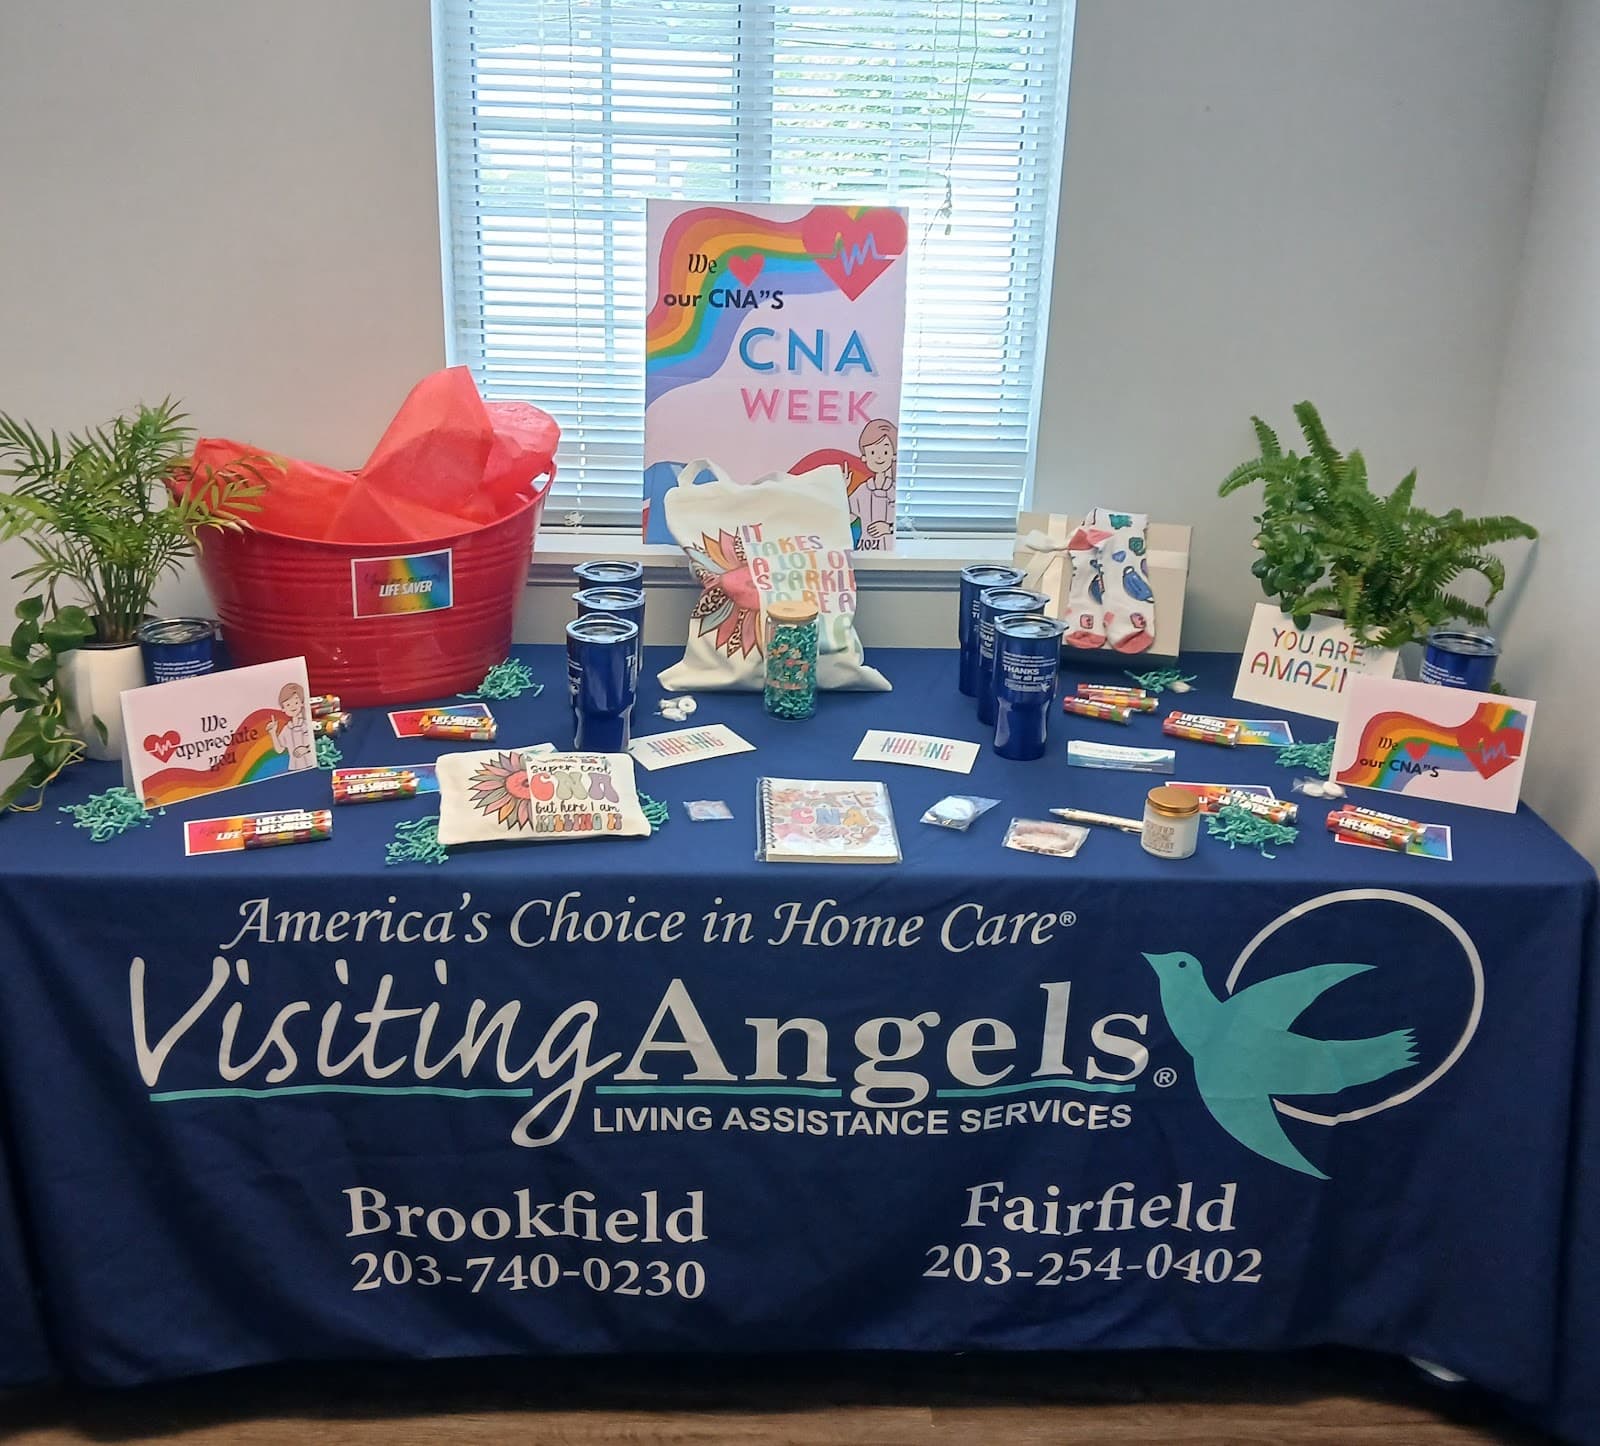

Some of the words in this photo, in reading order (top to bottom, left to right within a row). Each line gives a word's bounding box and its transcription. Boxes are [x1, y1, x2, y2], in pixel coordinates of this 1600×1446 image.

[688, 253, 718, 274] We
[663, 292, 702, 309] our
[738, 326, 878, 377] CNA
[740, 388, 878, 424] WEEK
[742, 523, 762, 543] IT
[749, 535, 824, 556] TAKES
[752, 557, 769, 576] A
[777, 550, 818, 570] LOT
[379, 584, 401, 597] LIFE
[402, 580, 433, 595] SAVER
[1273, 626, 1315, 654] YOU
[1319, 638, 1365, 665] ARE
[1002, 663, 1040, 675] THANKS
[201, 714, 228, 734] We
[176, 726, 259, 760] appreciate
[1379, 736, 1399, 750] We
[208, 751, 237, 773] you
[1359, 757, 1386, 769] our
[530, 770, 620, 804] CNA
[535, 801, 558, 814] but
[560, 800, 588, 814] here
[590, 801, 595, 812] I
[599, 803, 621, 813] am
[790, 806, 870, 827] CNA
[216, 829, 242, 841] LIFE
[510, 891, 686, 948] Choice
[701, 895, 754, 944] in
[767, 898, 925, 947] Home
[128, 955, 622, 1149] Visiting
[593, 1107, 713, 1133] LIVING
[722, 1107, 950, 1136] ASSISTANCE
[959, 1099, 1133, 1134] SERVICES
[341, 1186, 709, 1244] Brookfield
[960, 1181, 1238, 1236] Fairfield
[349, 1250, 706, 1300] 203-740-0230
[922, 1243, 1263, 1287] 203-254-0402
